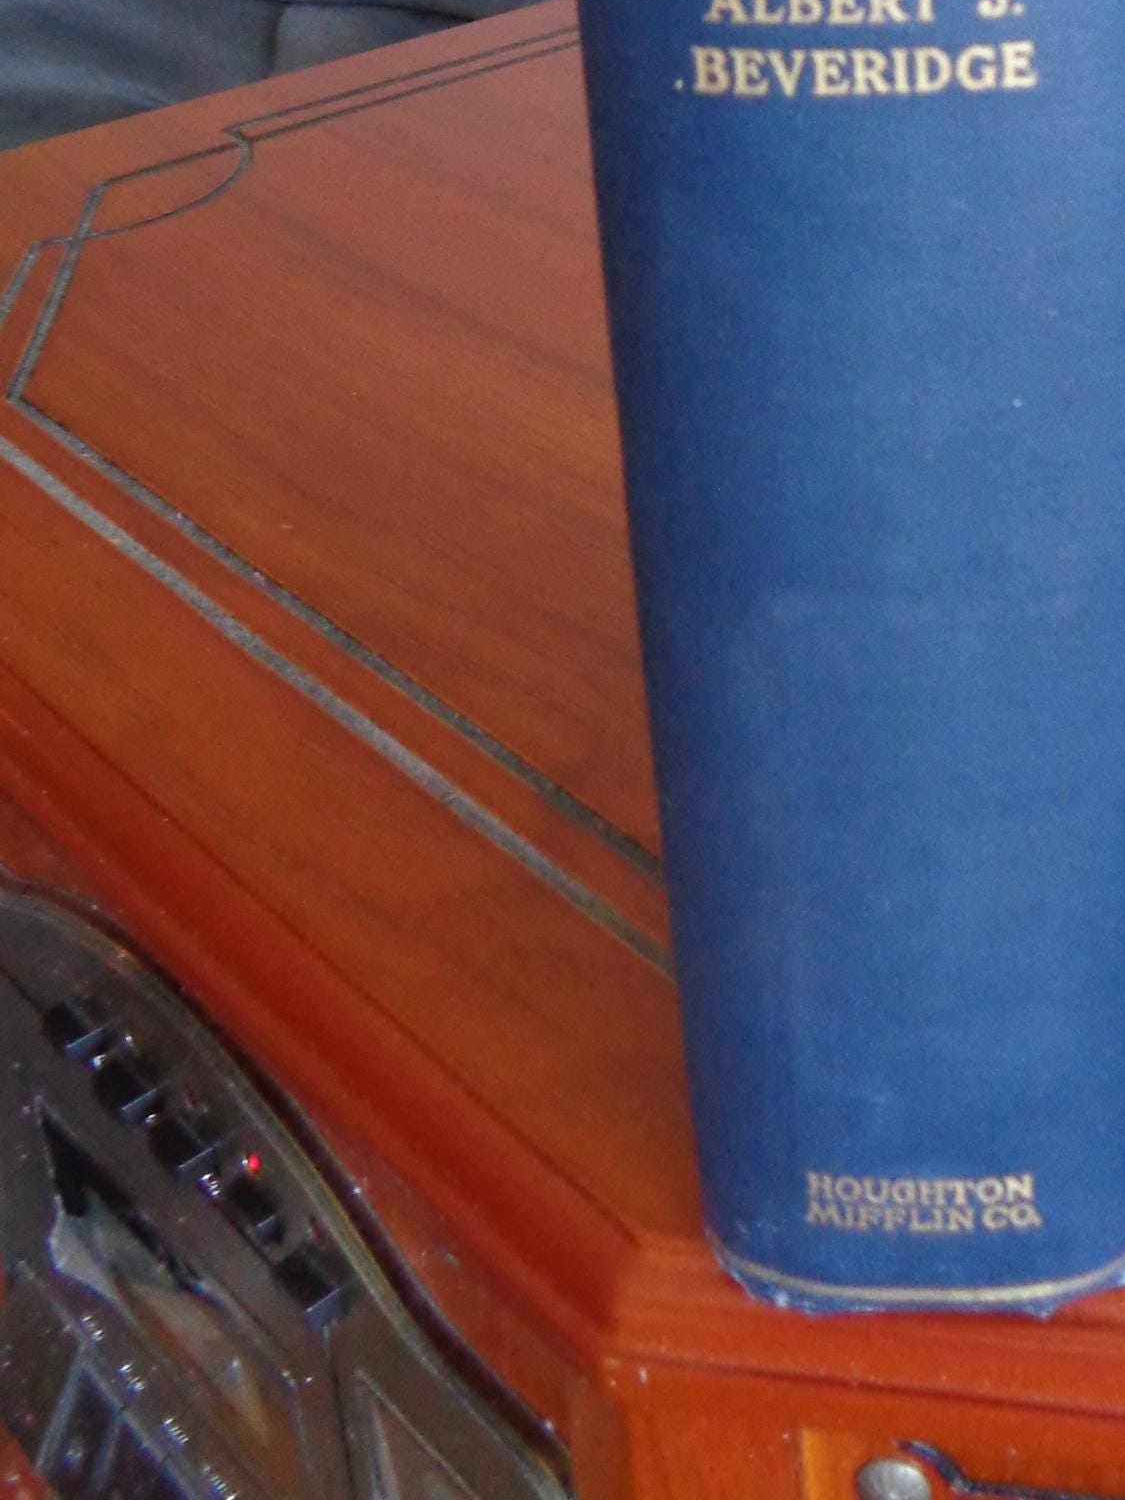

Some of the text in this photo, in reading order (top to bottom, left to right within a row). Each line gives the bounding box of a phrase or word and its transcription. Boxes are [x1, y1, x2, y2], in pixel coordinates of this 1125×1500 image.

[690, 39, 1039, 100] BEVERIDGE
[806, 1170, 1034, 1206] HOUGHTON
[805, 1199, 974, 1232] MIFFLIN
